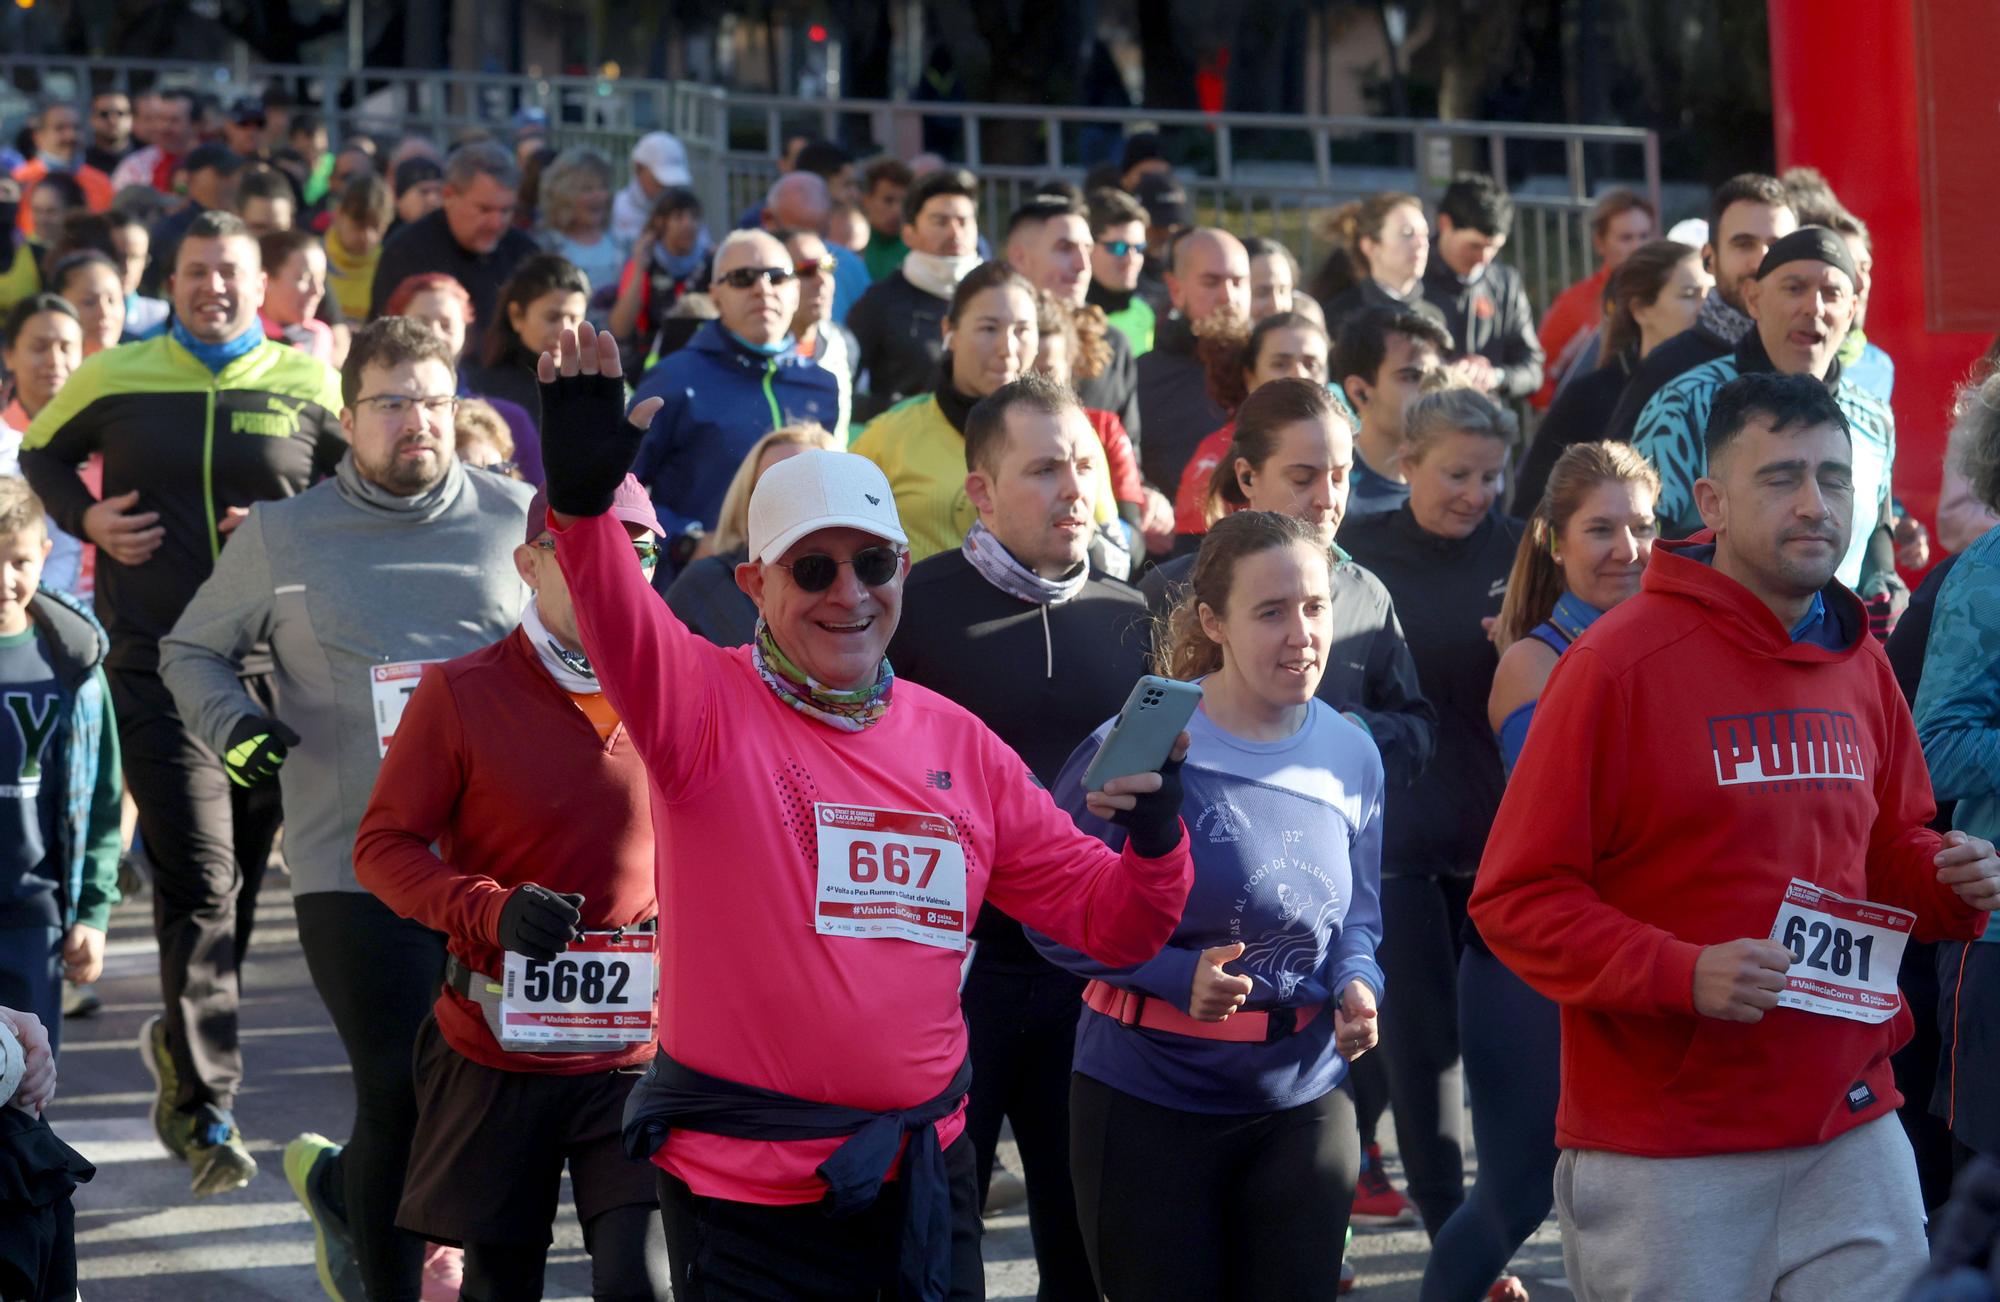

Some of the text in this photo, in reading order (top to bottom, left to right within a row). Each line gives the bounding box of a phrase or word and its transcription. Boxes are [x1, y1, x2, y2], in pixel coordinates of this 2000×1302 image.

[4, 691, 60, 783] Y
[1708, 708, 1865, 786] PUMA
[849, 840, 941, 889] 667
[834, 886, 850, 895] Volta
[916, 894, 925, 902] de
[1234, 898, 1247, 912] AL
[1243, 864, 1270, 894] PORT
[1272, 858, 1287, 870] DE
[1292, 858, 1338, 898] VALENCIA
[852, 906, 921, 921] #ValènciaCorre
[937, 918, 959, 926] popular
[1783, 915, 1874, 982] 6281
[524, 959, 630, 1004] 5682
[1791, 979, 1854, 1001] #ValènciaCorre
[1870, 998, 1894, 1007] popular
[539, 1016, 608, 1025] #ValènciaCorre
